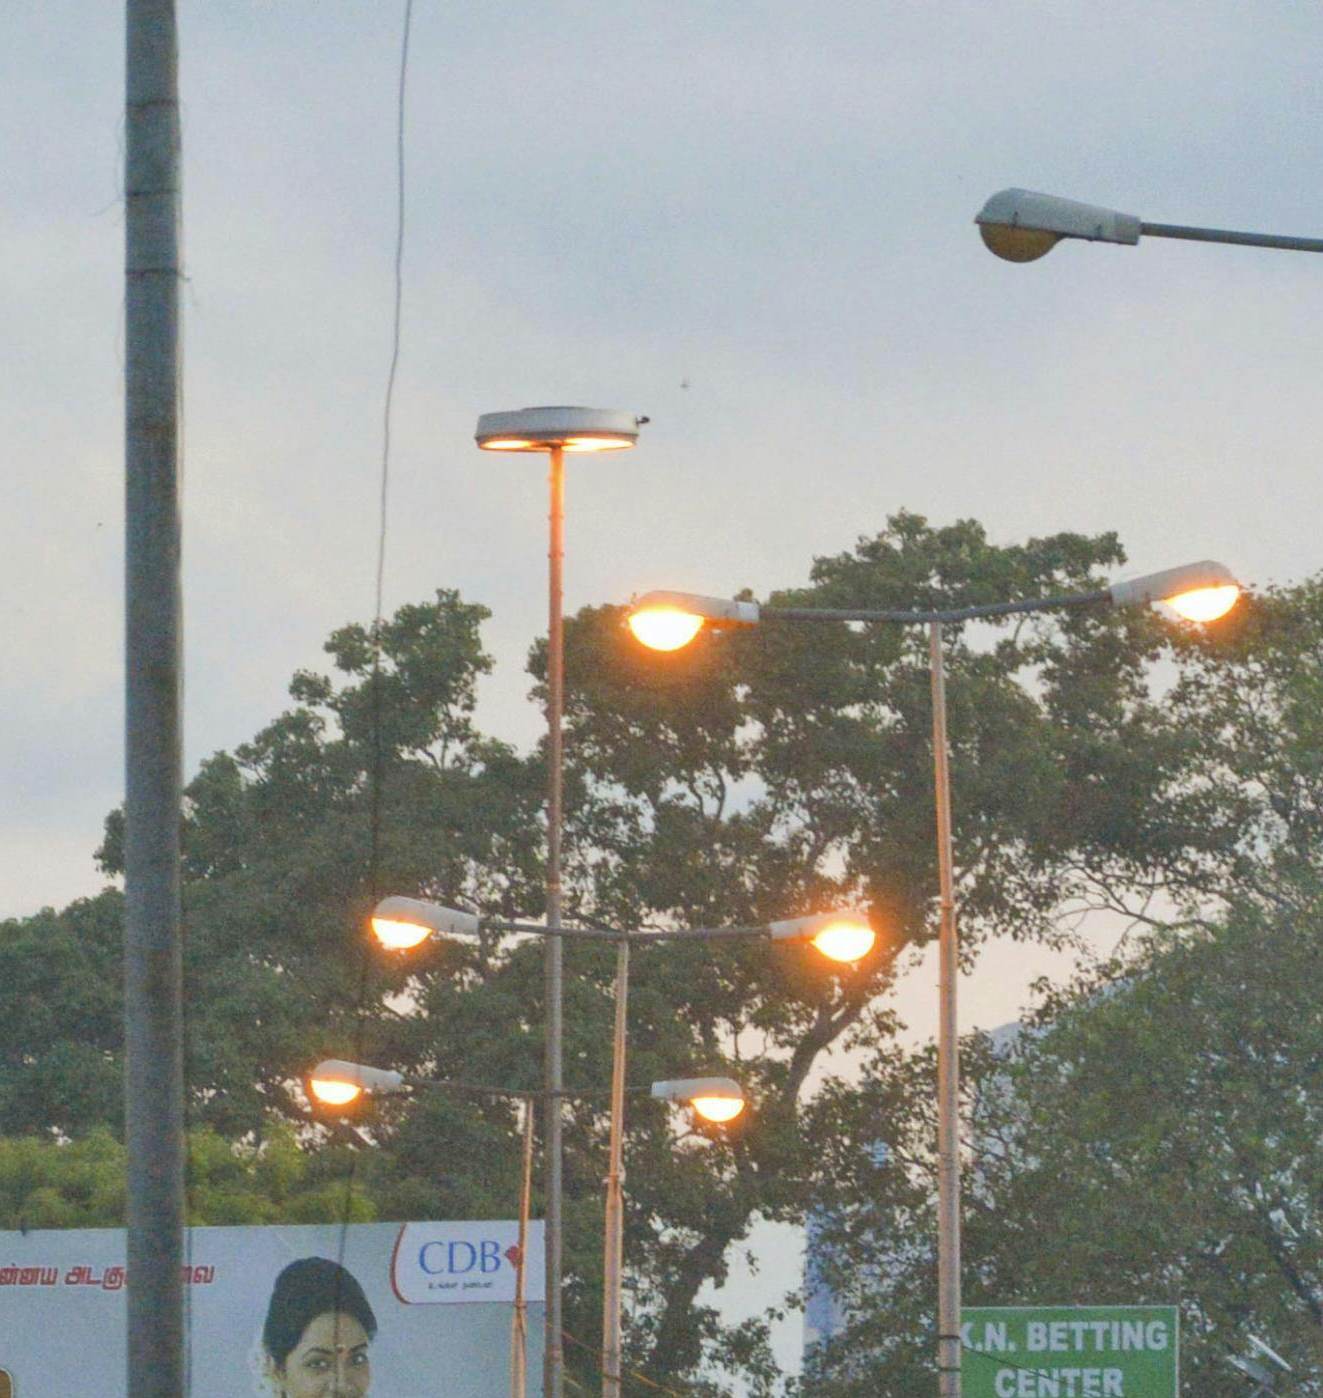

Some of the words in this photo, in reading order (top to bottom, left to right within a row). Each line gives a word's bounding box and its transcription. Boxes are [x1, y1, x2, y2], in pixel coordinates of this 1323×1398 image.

[418, 1241, 501, 1274] CDB
[1027, 1321, 1168, 1351] BETTING
[995, 1367, 1124, 1398] CENTER
